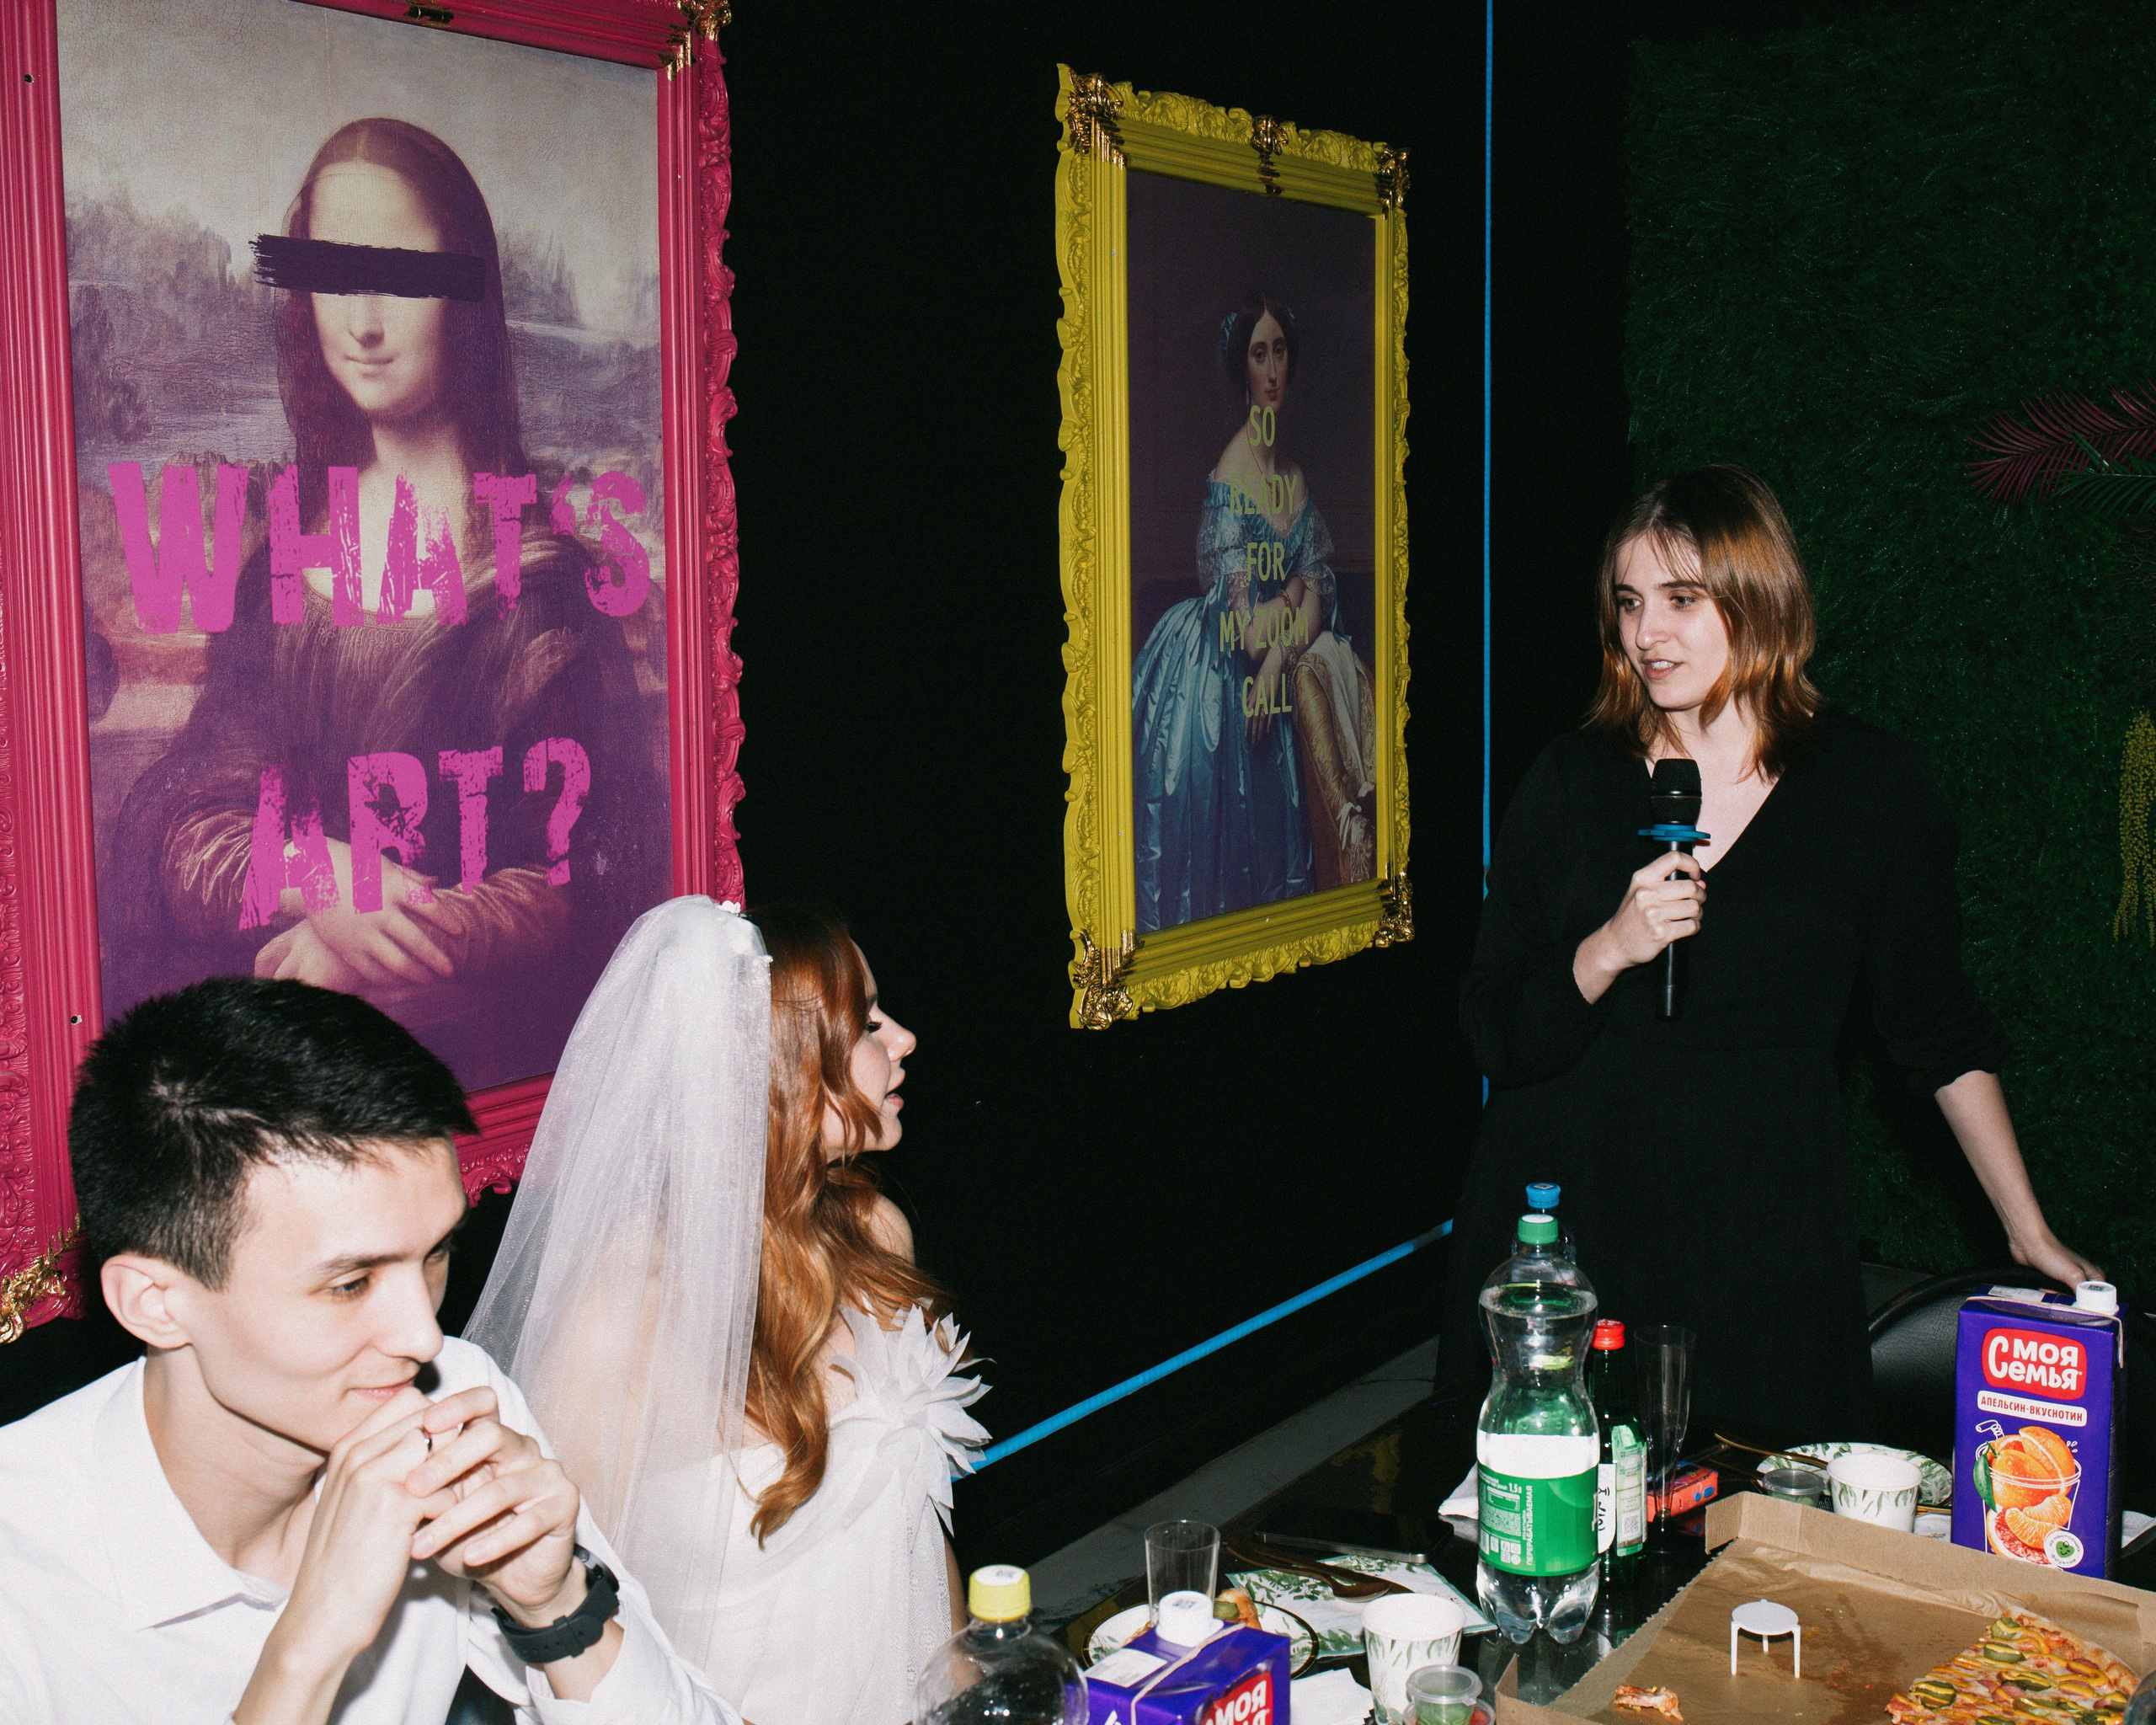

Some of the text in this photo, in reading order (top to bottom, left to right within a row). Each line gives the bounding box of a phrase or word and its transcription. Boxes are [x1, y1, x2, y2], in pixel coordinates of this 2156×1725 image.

[1249, 404, 1276, 447] SO
[1229, 473, 1298, 515] READY
[107, 461, 651, 635] WHAT'S
[1246, 542, 1286, 581] FOR
[1219, 606, 1310, 653] MY ZOOM
[1241, 673, 1293, 718] CALL
[238, 737, 593, 932] ART?
[1980, 1396, 2084, 1423] АПЕЛЬСИН-ВКУСНОТИН
